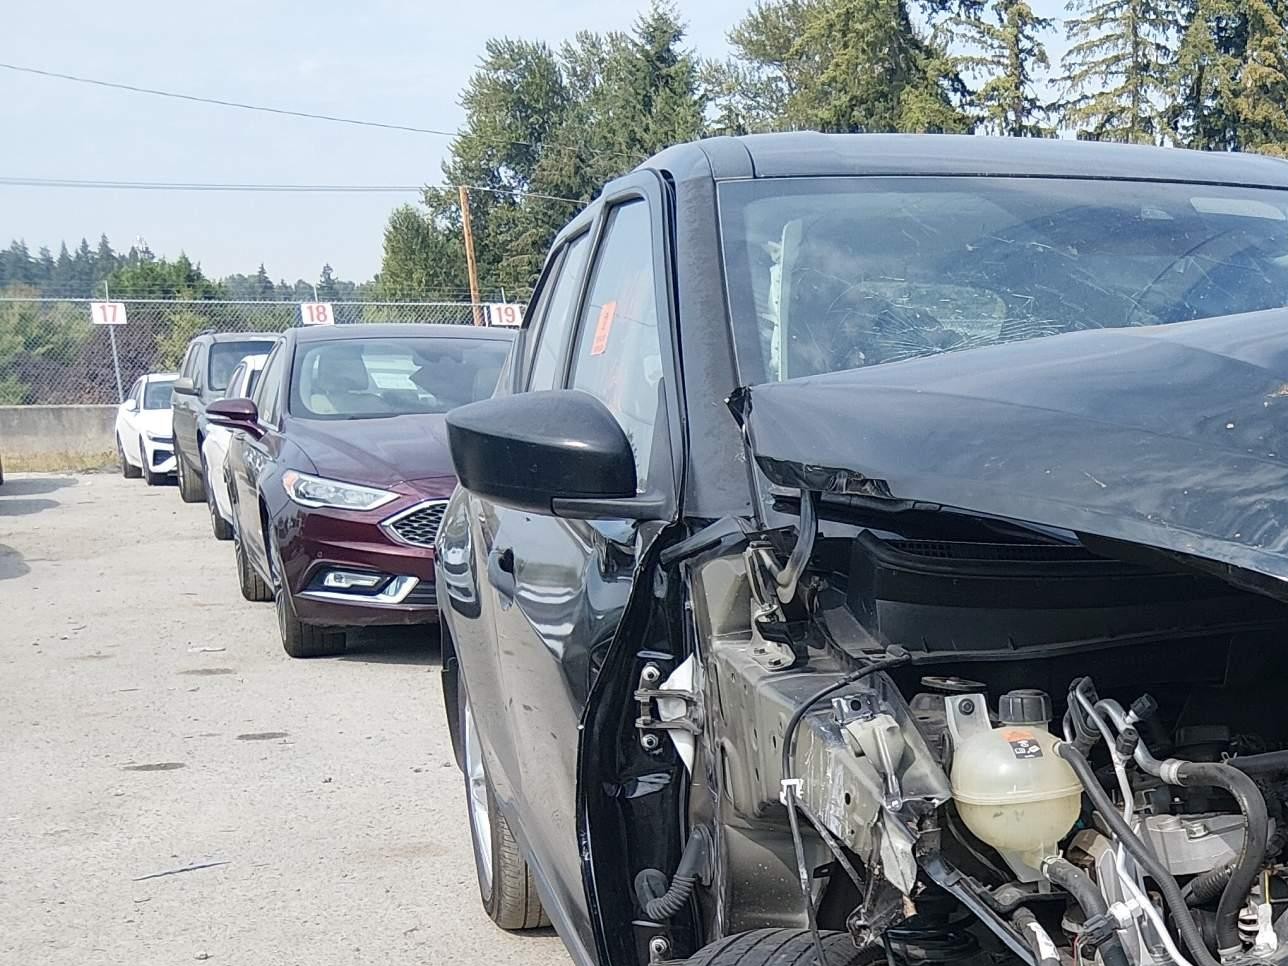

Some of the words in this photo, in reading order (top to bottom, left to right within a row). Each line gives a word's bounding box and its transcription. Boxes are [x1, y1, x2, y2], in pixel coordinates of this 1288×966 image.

[98, 304, 118, 323] 17
[305, 304, 328, 323] 18
[495, 305, 516, 324] 19
